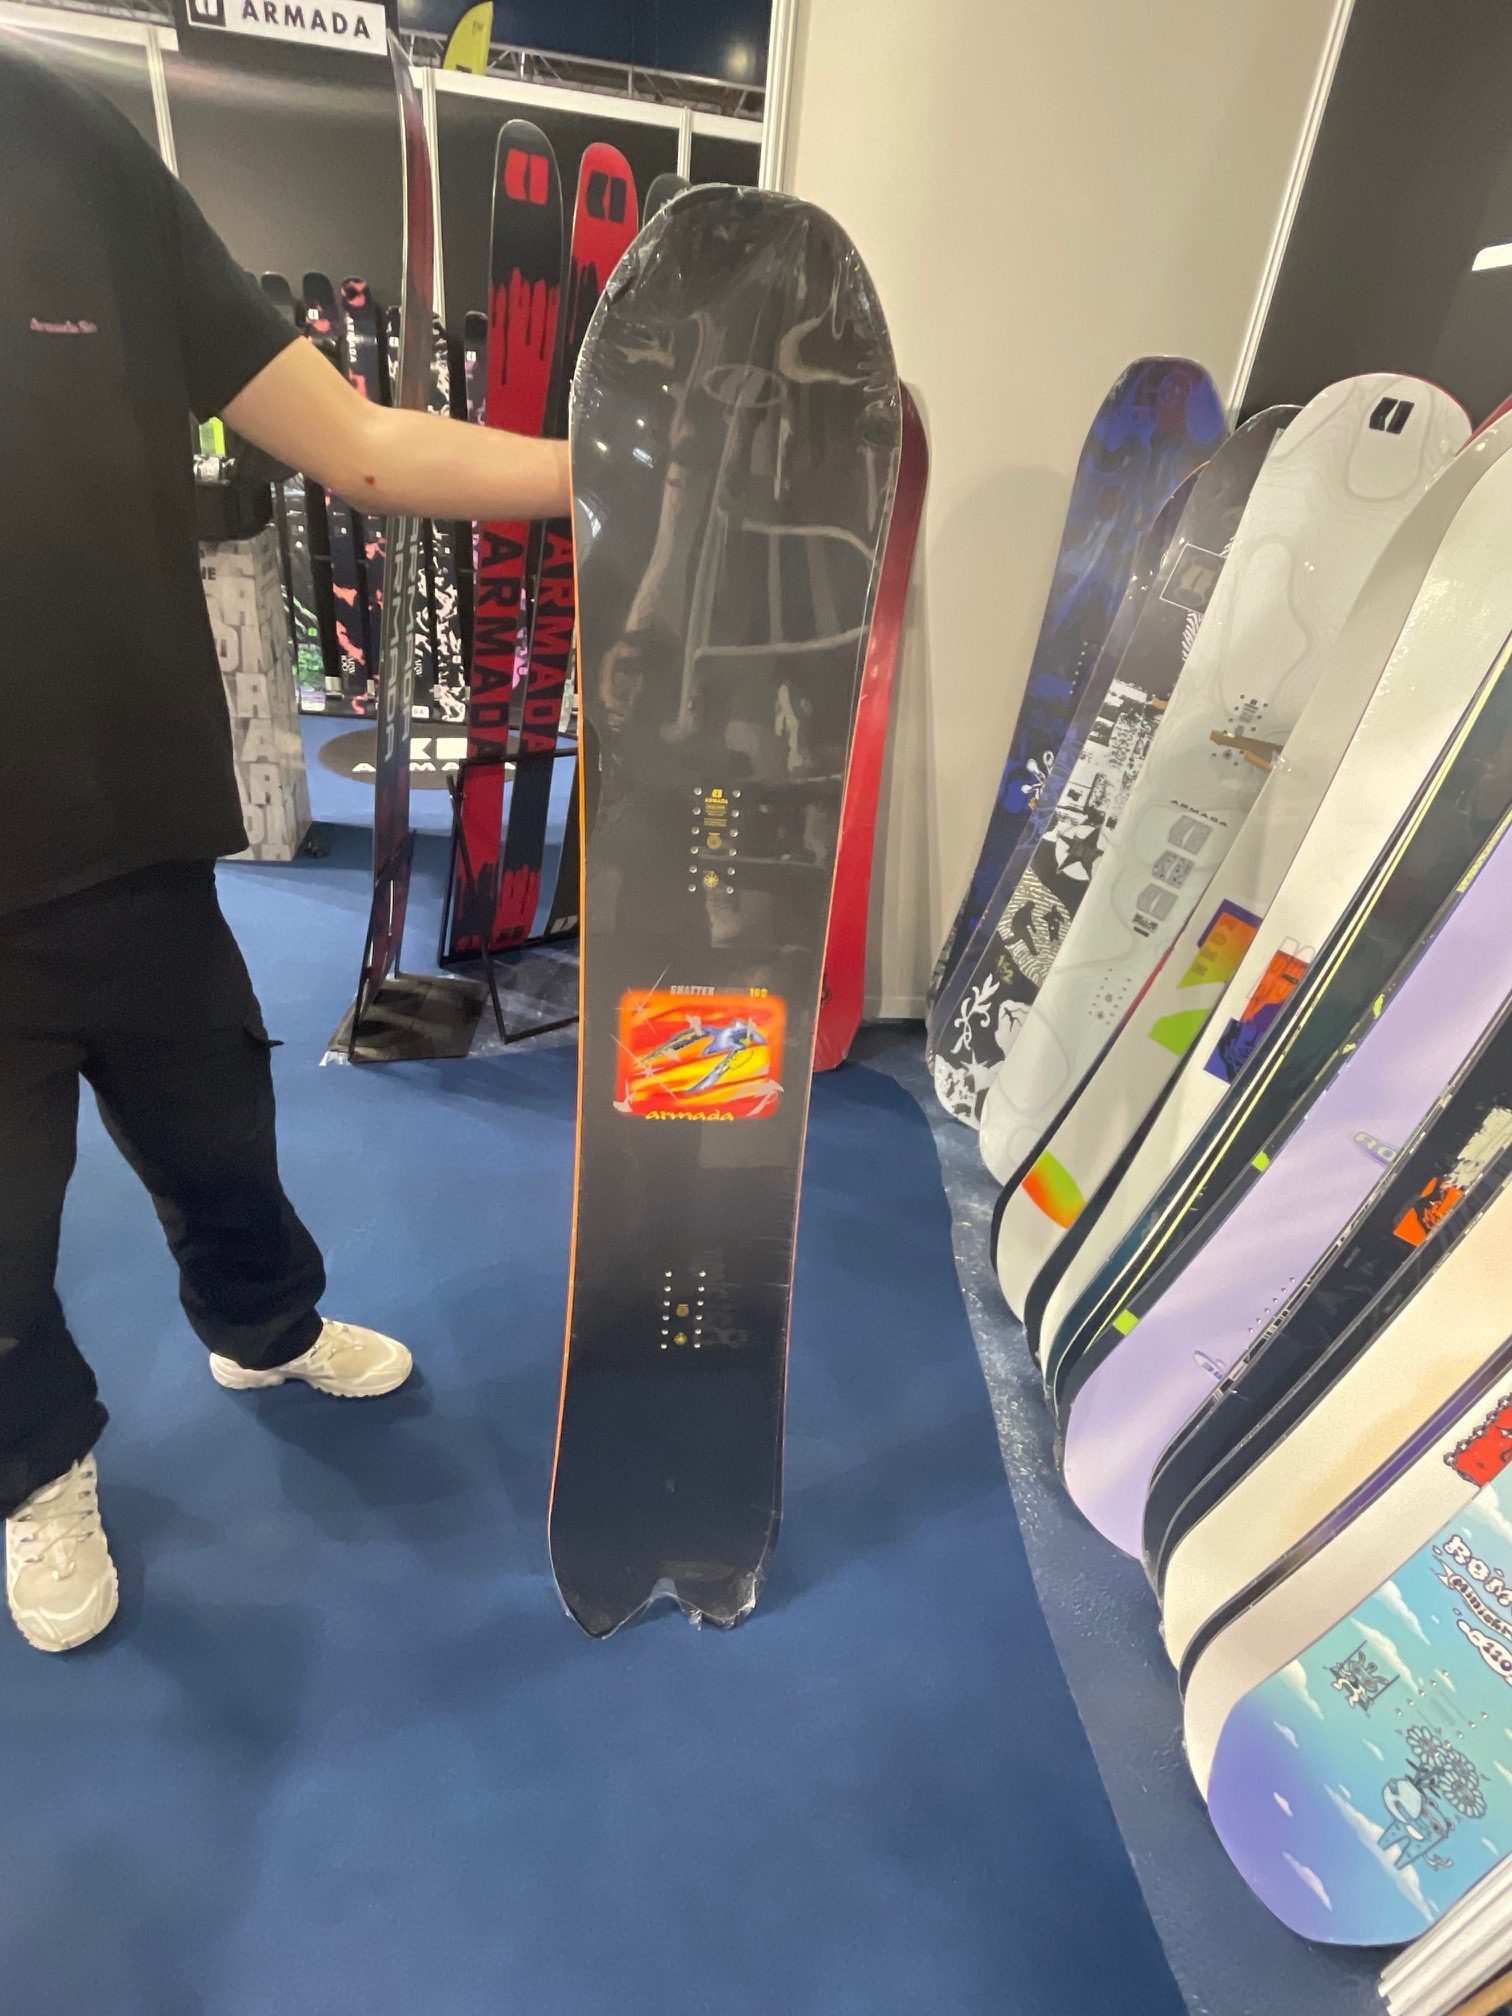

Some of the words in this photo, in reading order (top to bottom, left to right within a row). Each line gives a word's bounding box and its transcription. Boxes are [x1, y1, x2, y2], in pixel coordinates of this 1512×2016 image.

[242, 0, 371, 39] ARMADA
[469, 530, 526, 760] ARMADA
[522, 532, 576, 752] ARMADA
[645, 1108, 735, 1121] armada
